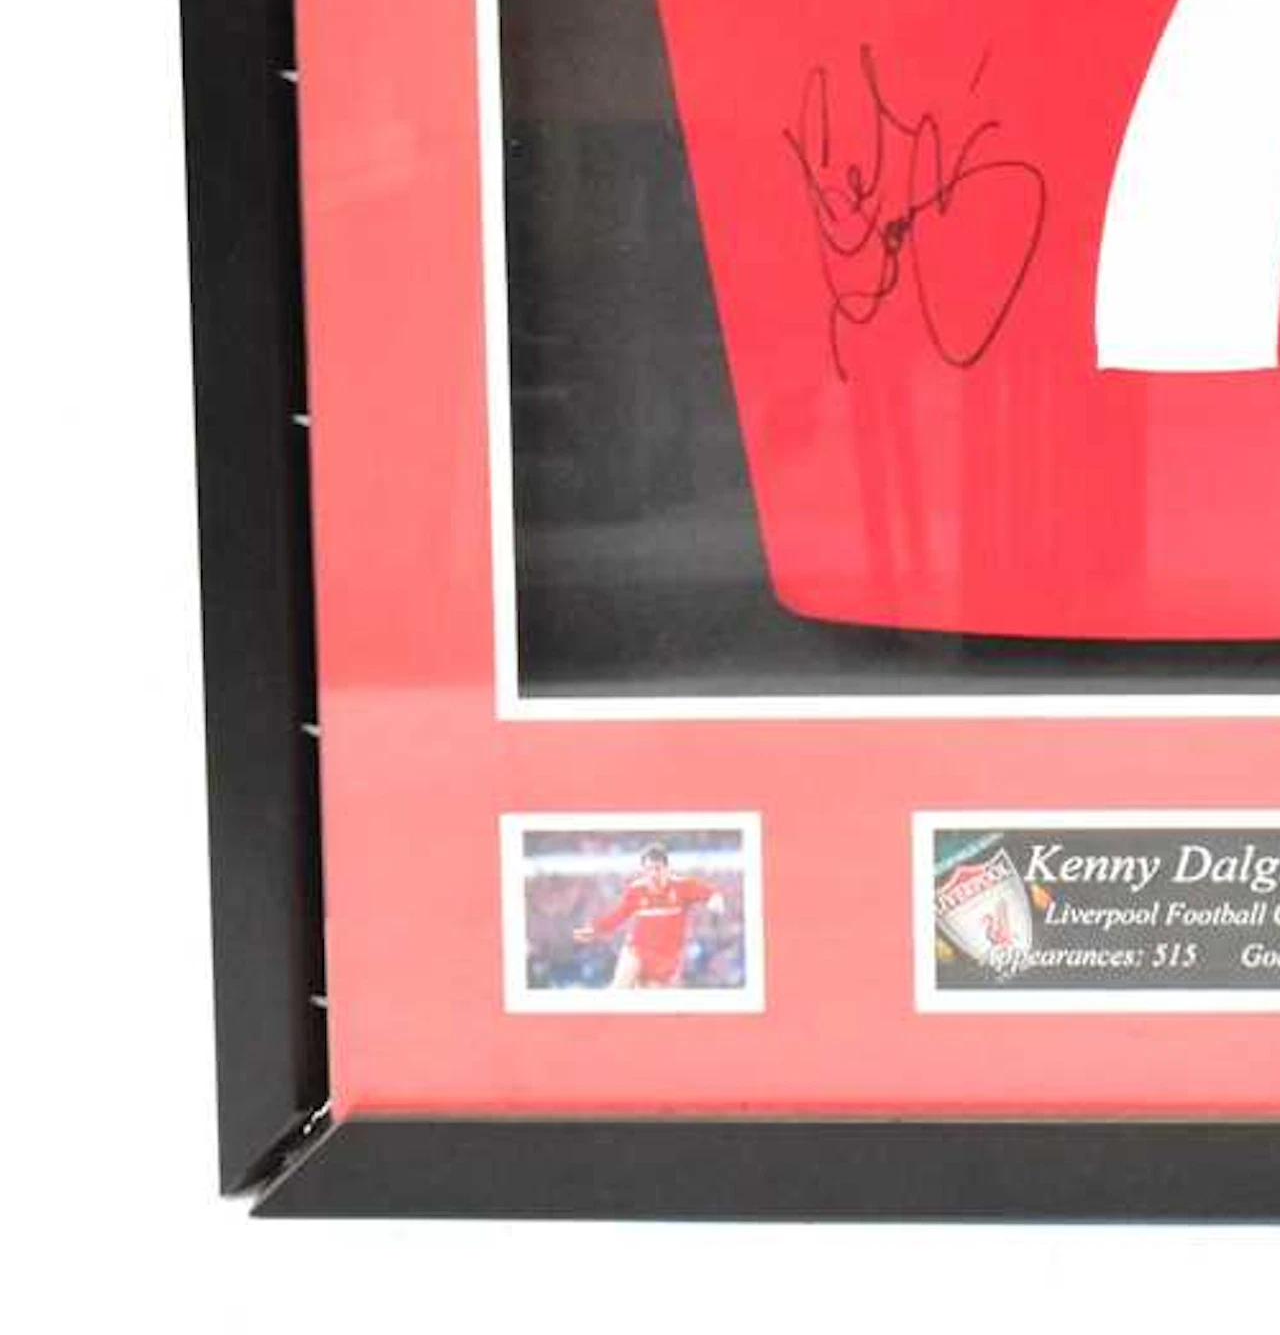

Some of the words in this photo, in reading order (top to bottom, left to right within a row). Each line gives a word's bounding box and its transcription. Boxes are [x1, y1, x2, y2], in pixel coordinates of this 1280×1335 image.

[1023, 843, 1162, 893] Kenny
[1044, 901, 1160, 931] Liverpool
[1164, 901, 1267, 927] Football
[1152, 942, 1198, 968] 515
